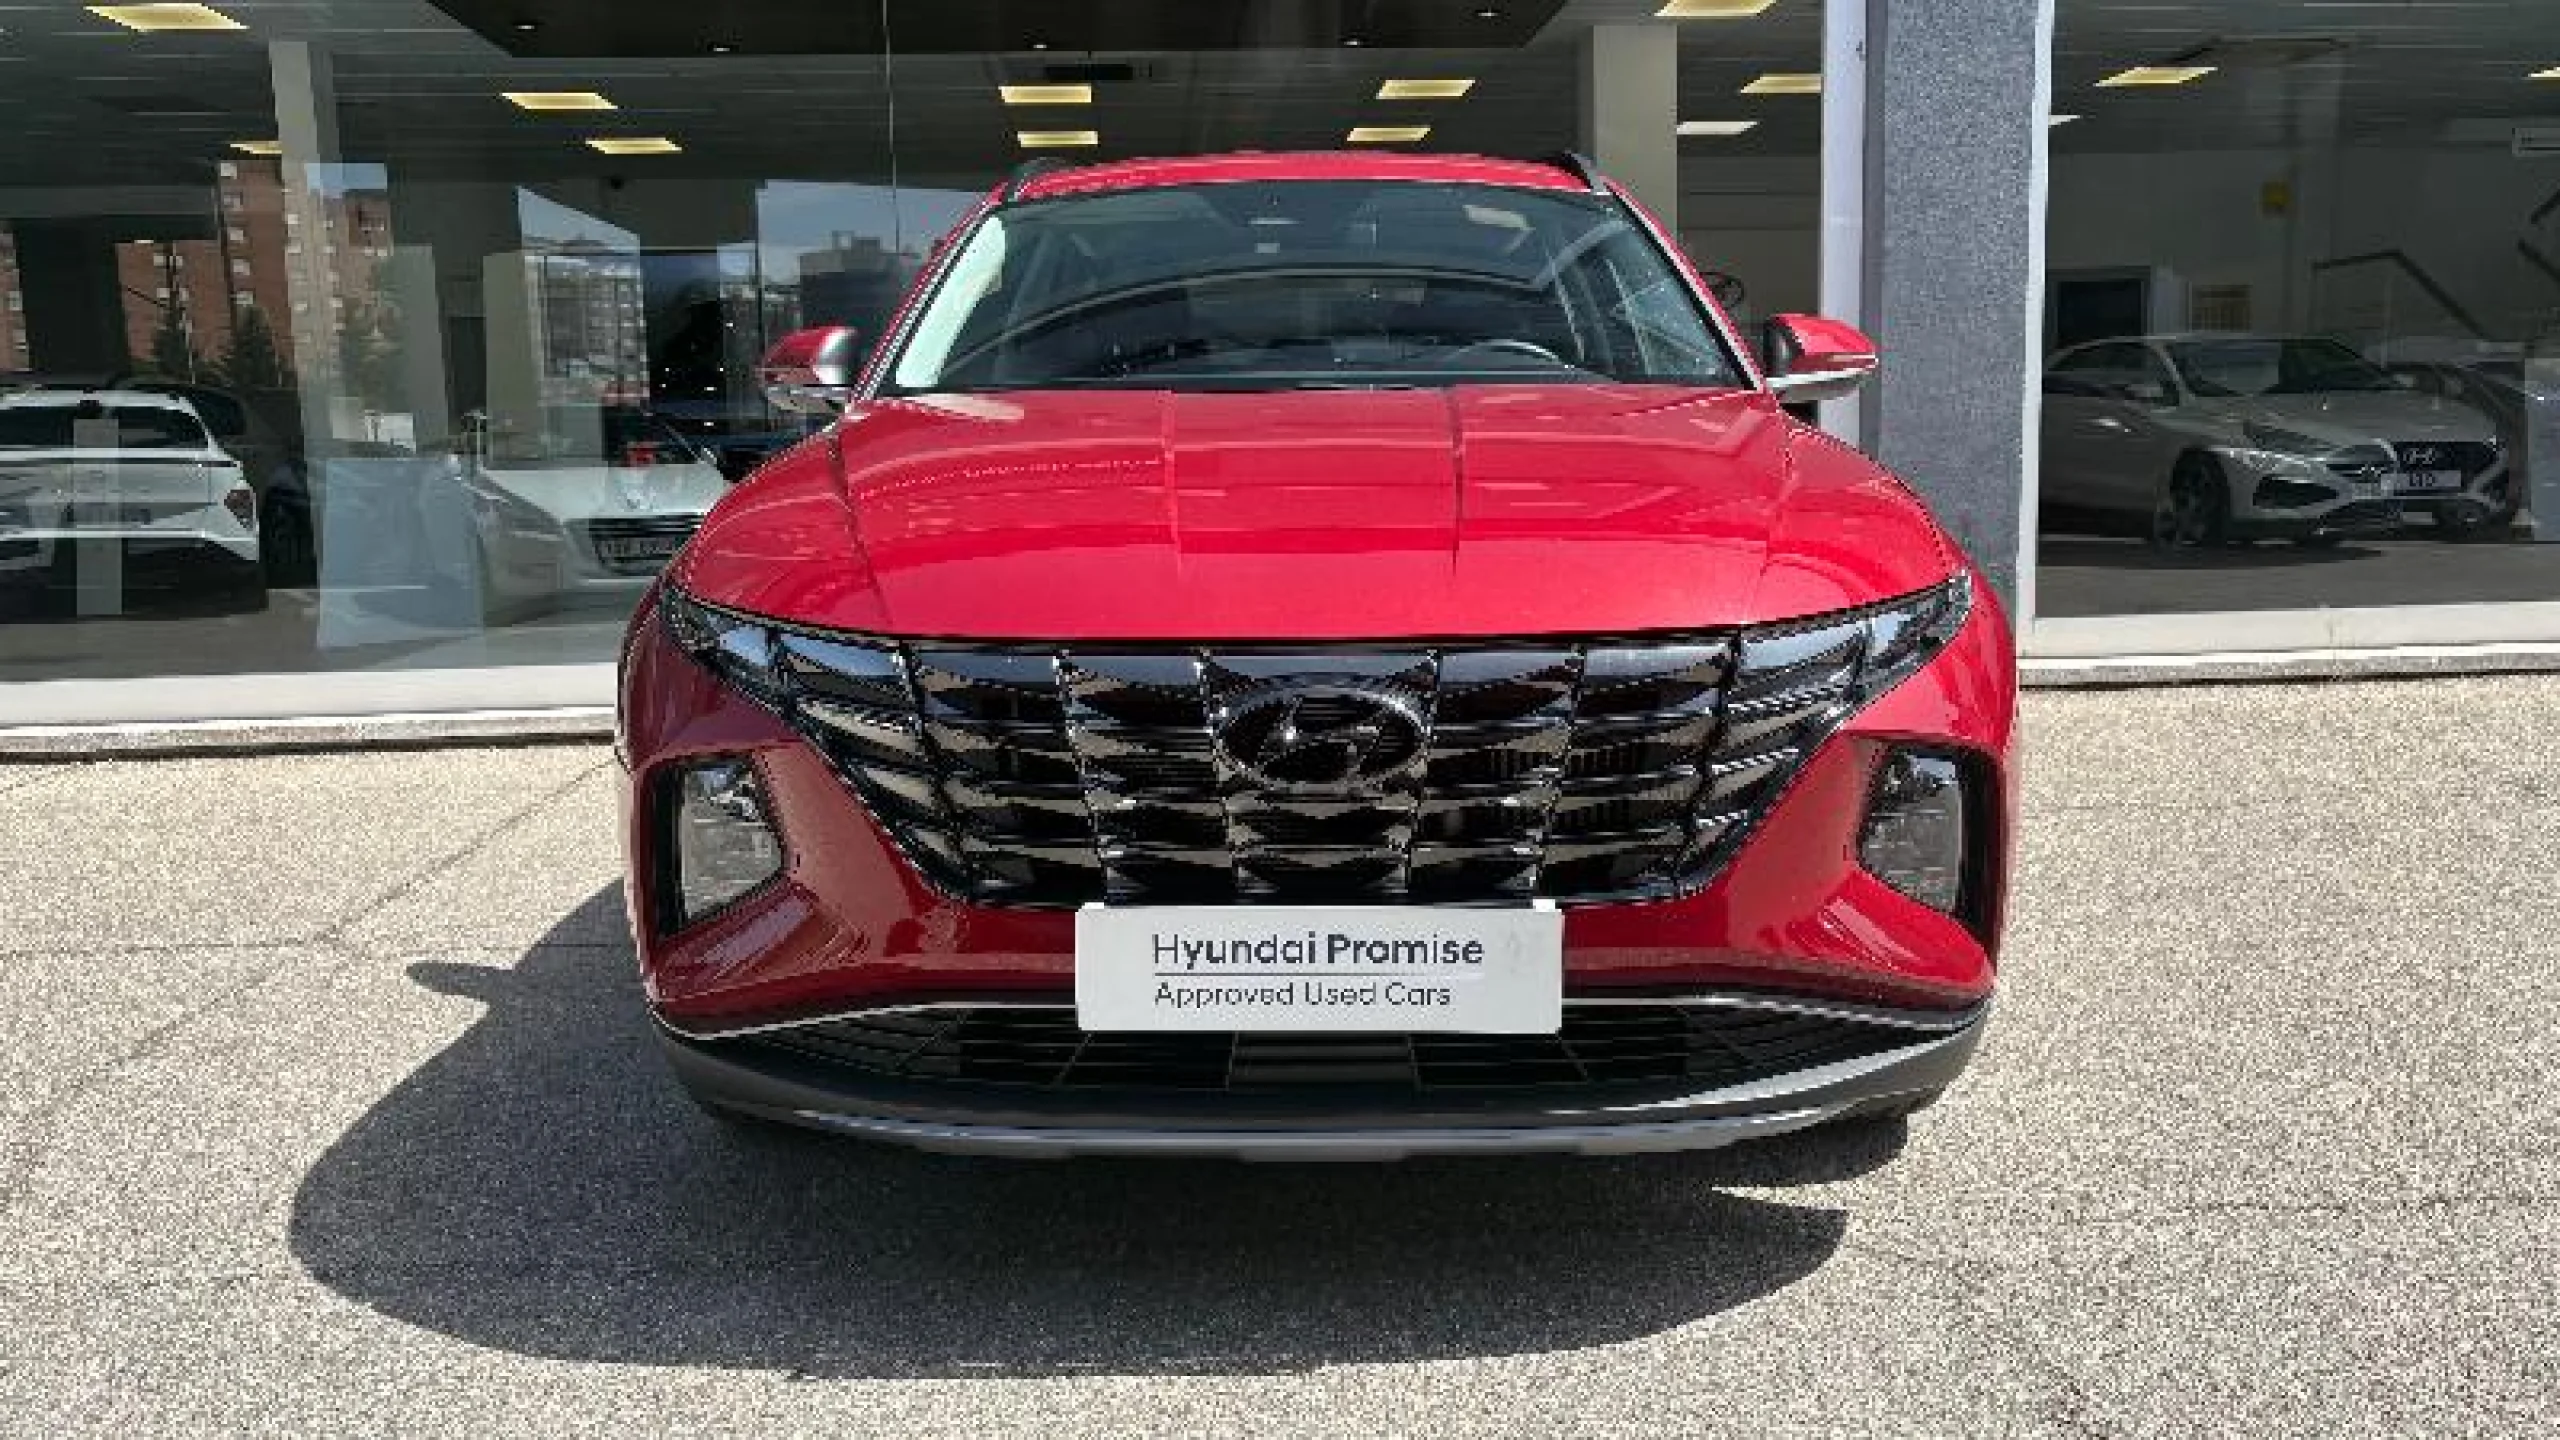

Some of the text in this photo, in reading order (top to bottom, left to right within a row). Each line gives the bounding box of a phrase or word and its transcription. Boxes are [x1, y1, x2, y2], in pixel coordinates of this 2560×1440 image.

[1152, 931, 1485, 970] Hyundai Promise
[1154, 981, 1451, 1009] Approved Used Cars
